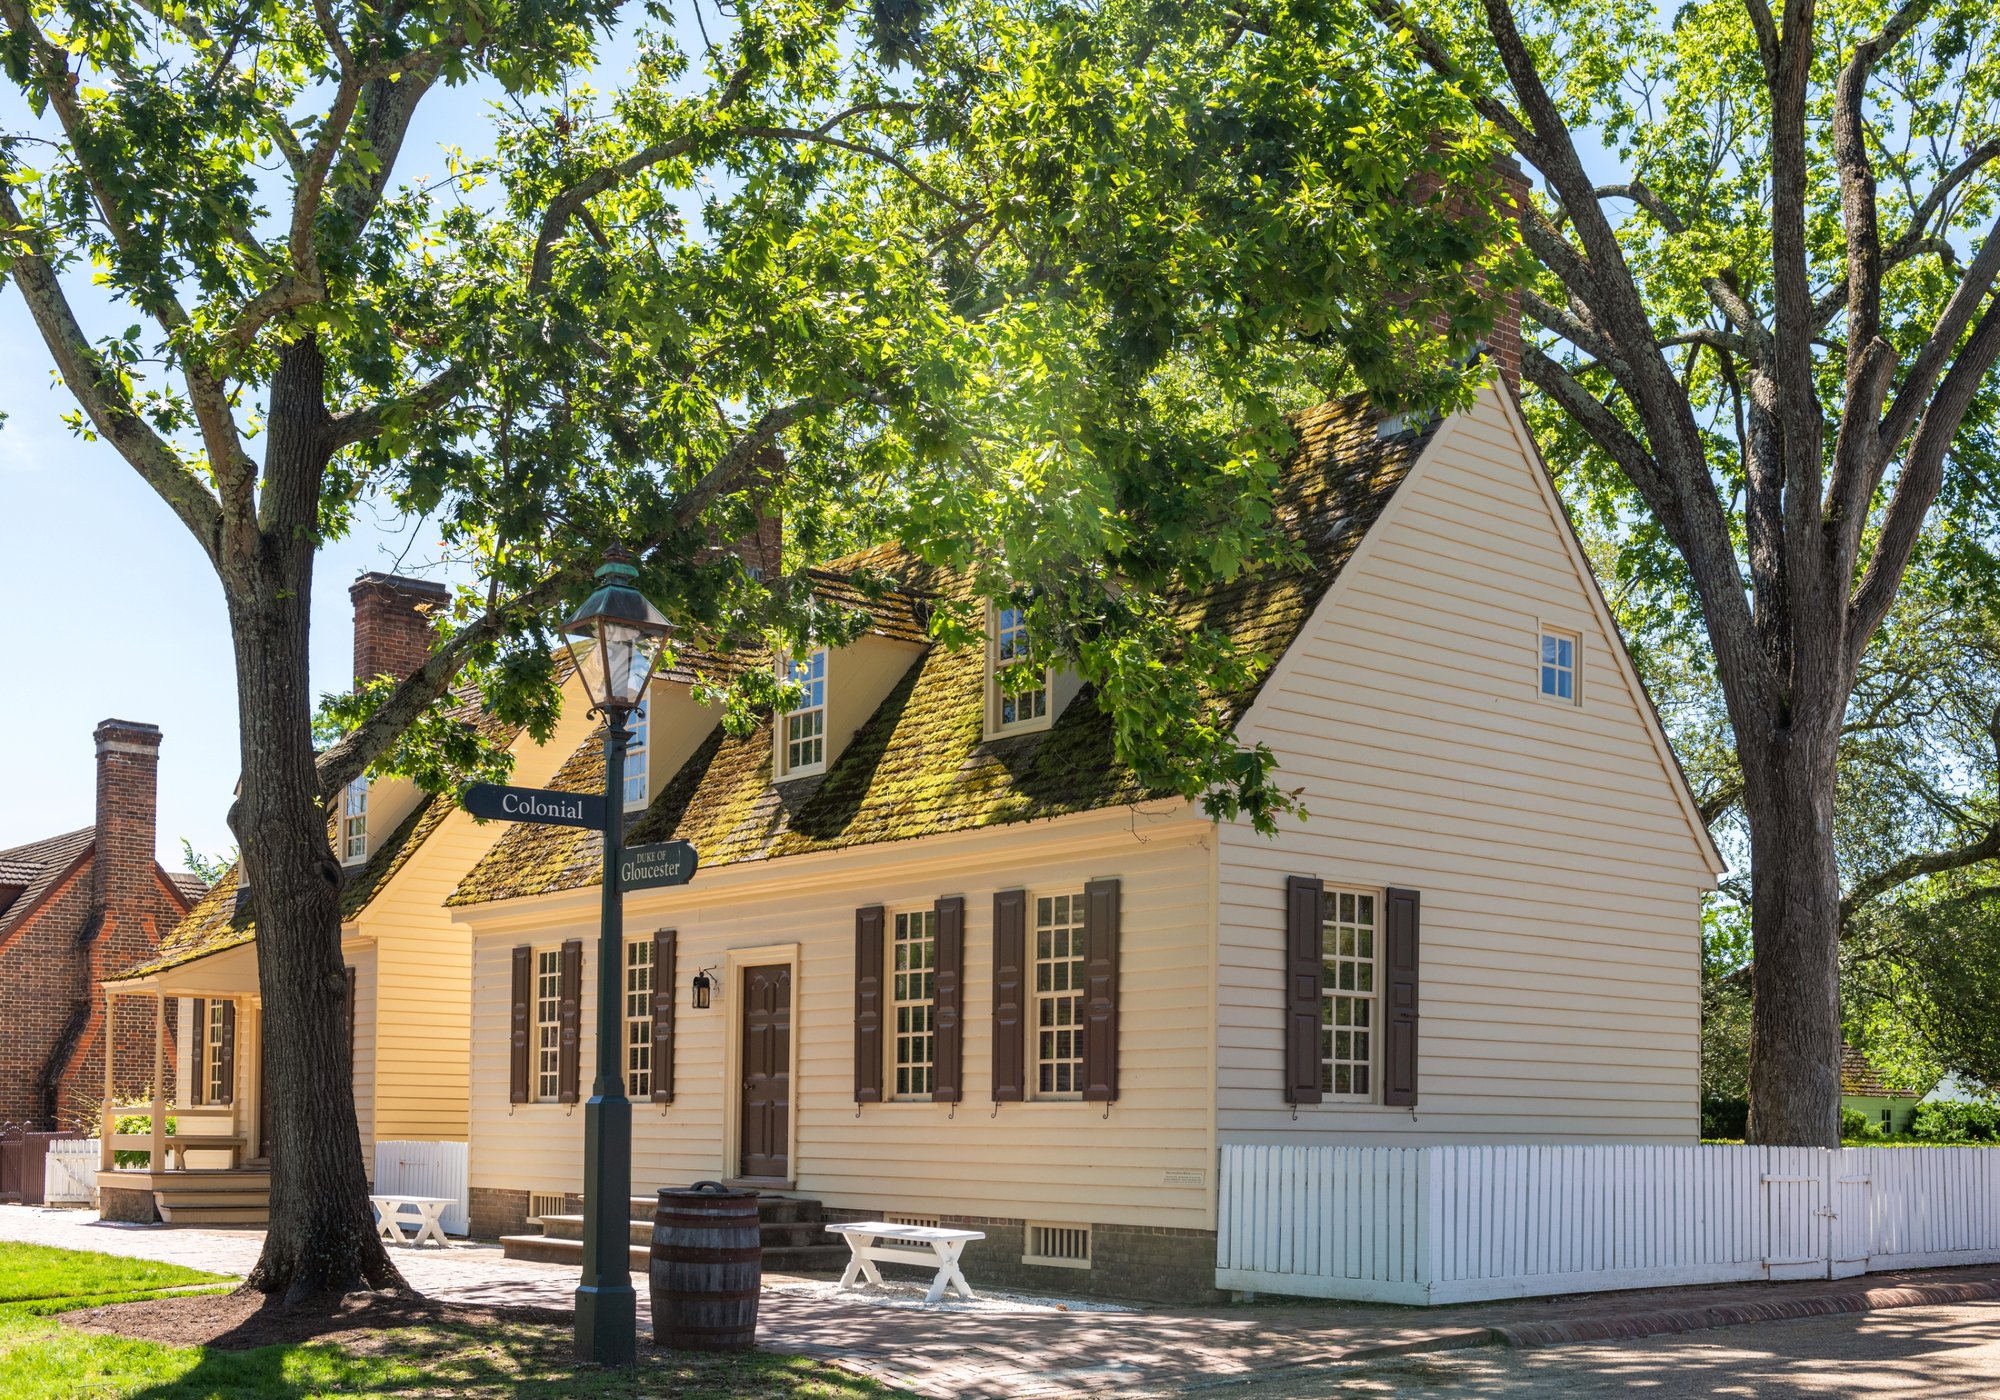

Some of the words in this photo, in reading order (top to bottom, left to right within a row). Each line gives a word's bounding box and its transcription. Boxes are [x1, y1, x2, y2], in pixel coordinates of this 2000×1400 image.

[502, 793, 583, 820] Colonial
[636, 852, 655, 864] DUKE
[656, 850, 667, 861] OF
[621, 862, 680, 882] Gloucester
